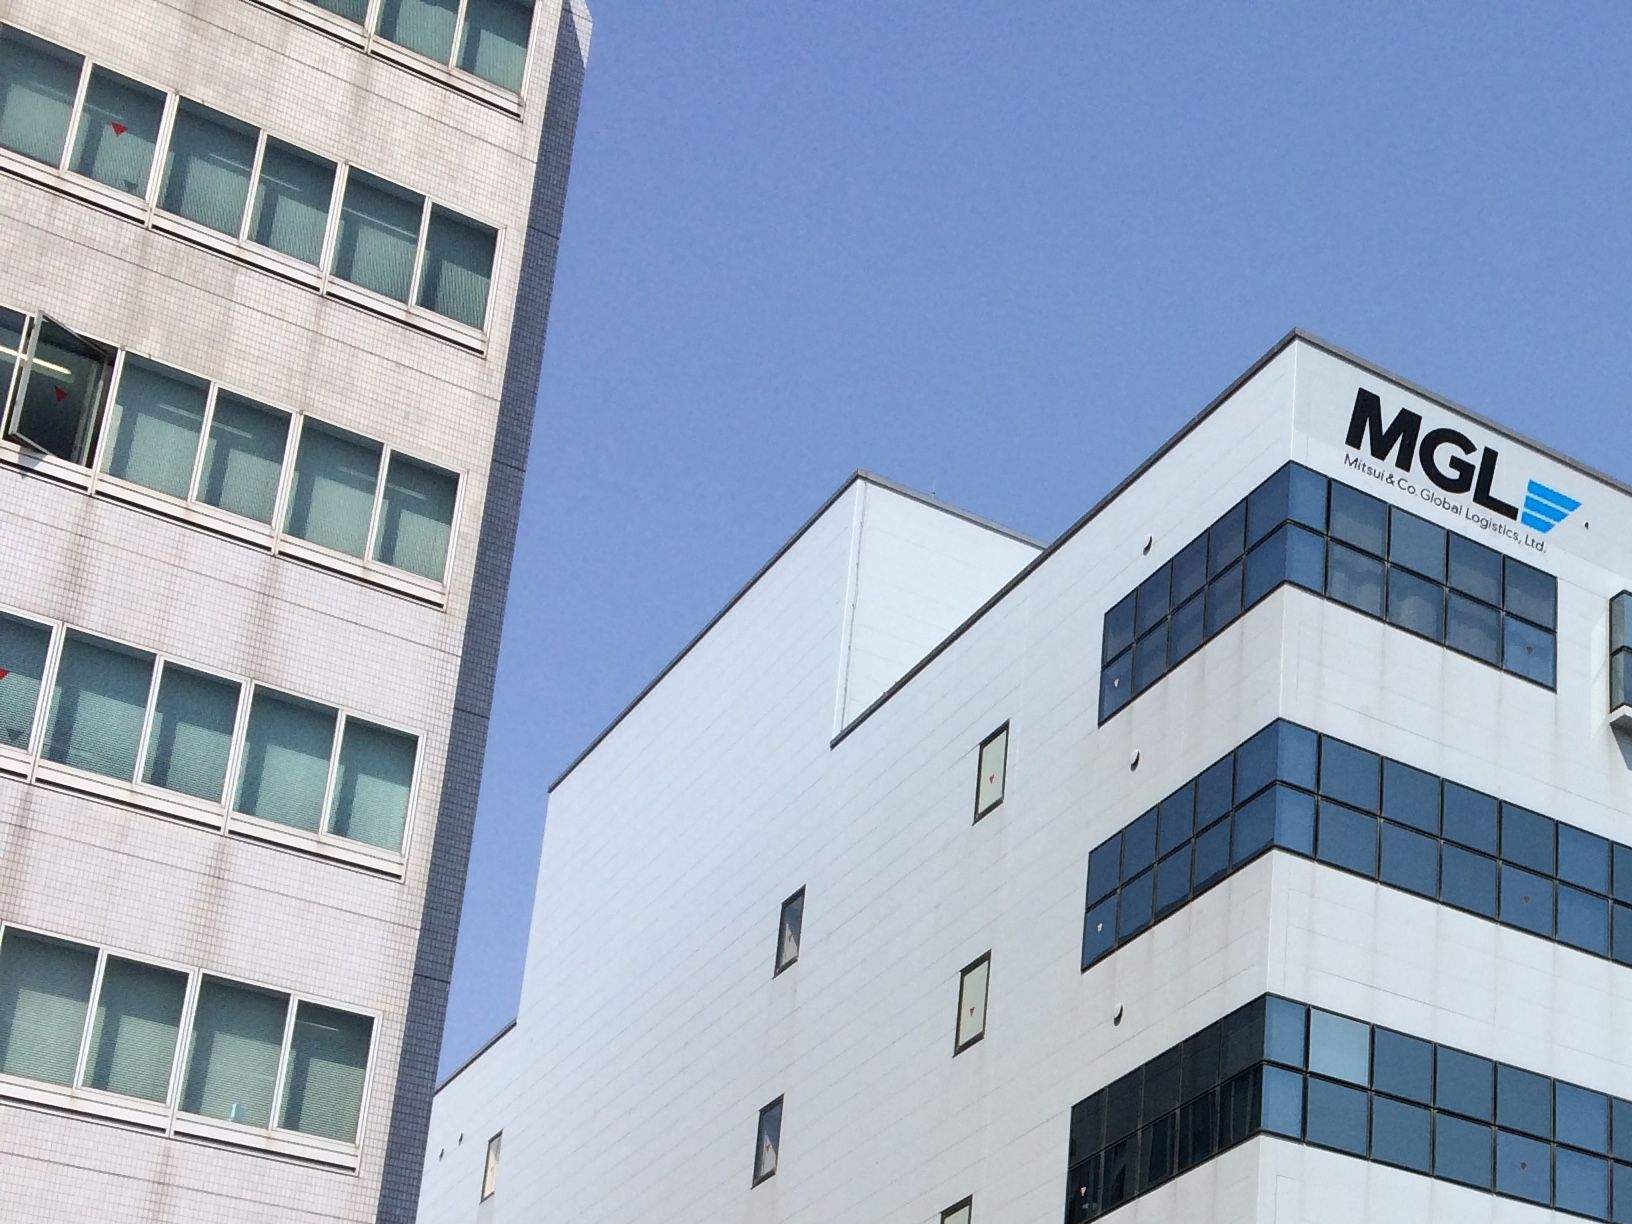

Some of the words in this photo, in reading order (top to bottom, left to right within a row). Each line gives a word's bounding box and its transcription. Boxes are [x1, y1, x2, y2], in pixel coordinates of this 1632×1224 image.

[1344, 453, 1385, 481] Mitsui
[1385, 473, 1396, 486] &
[1397, 478, 1419, 497] Co.
[1420, 488, 1463, 517] Global
[1466, 507, 1522, 545] Logistics,
[1525, 533, 1547, 553] Ltd.
[1345, 387, 1519, 521] MGL
